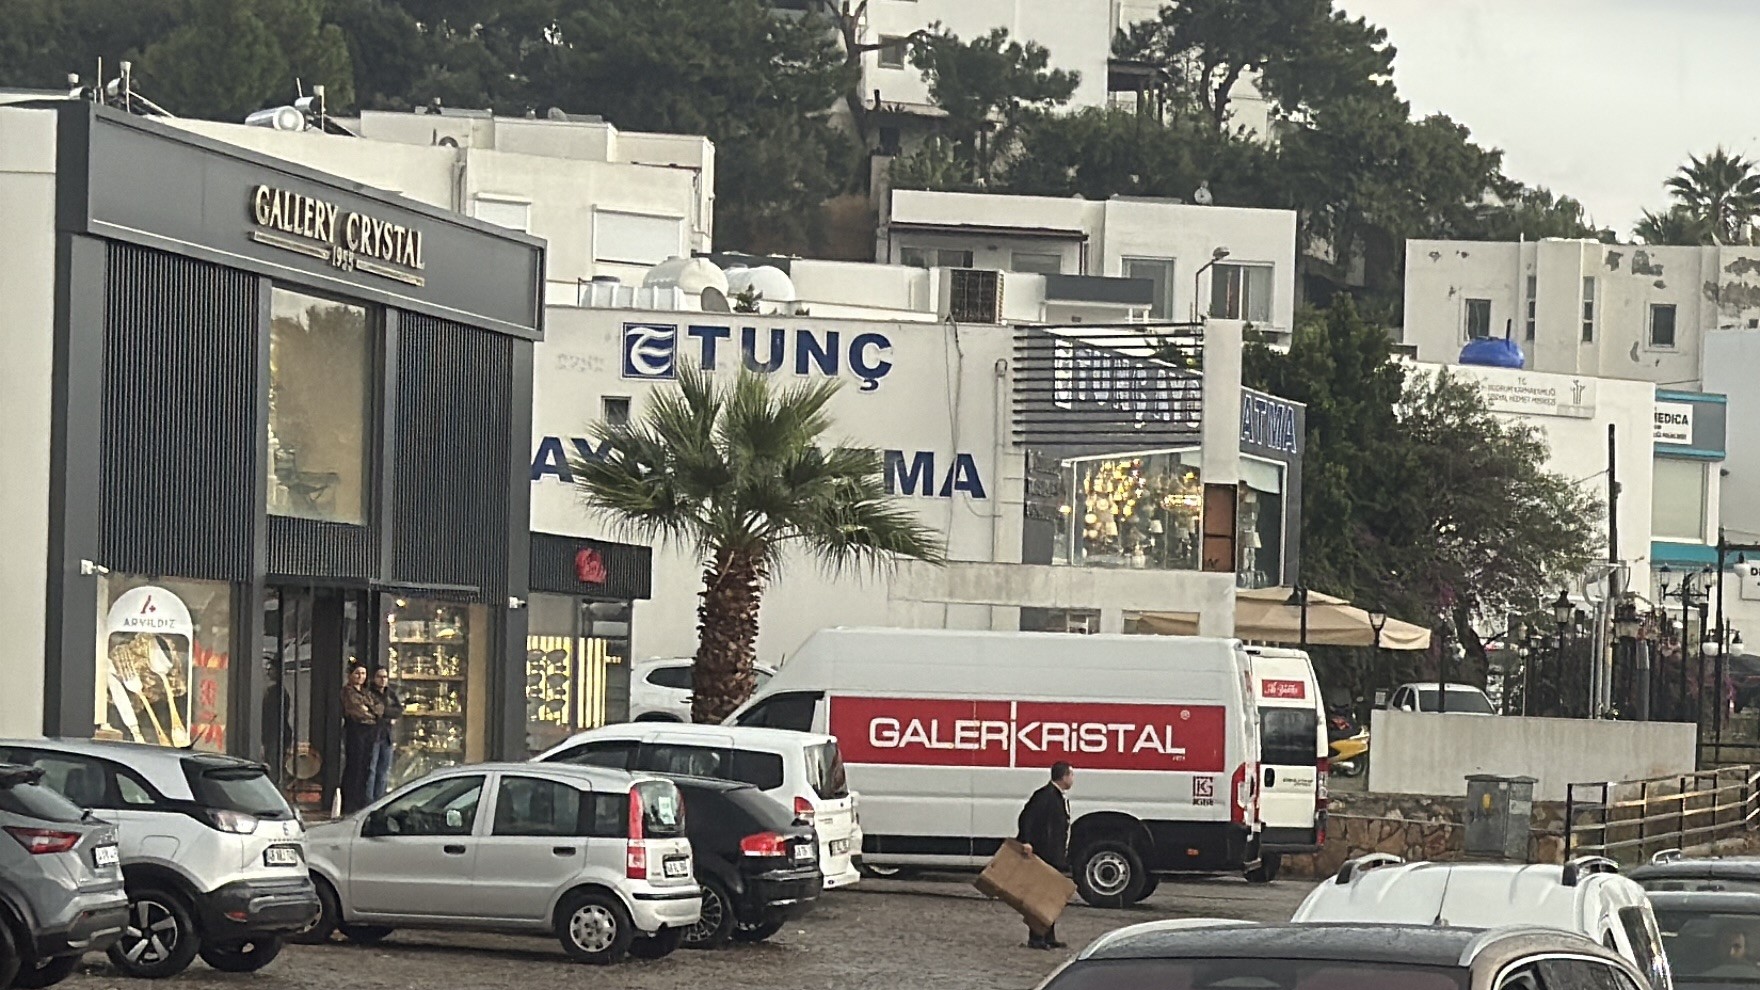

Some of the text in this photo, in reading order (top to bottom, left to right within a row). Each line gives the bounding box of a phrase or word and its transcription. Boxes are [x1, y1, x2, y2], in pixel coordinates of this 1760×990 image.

[255, 184, 426, 270] GALLERY CRYSTAL
[688, 325, 893, 391] TUNÇ
[1654, 412, 1689, 425] EDICA
